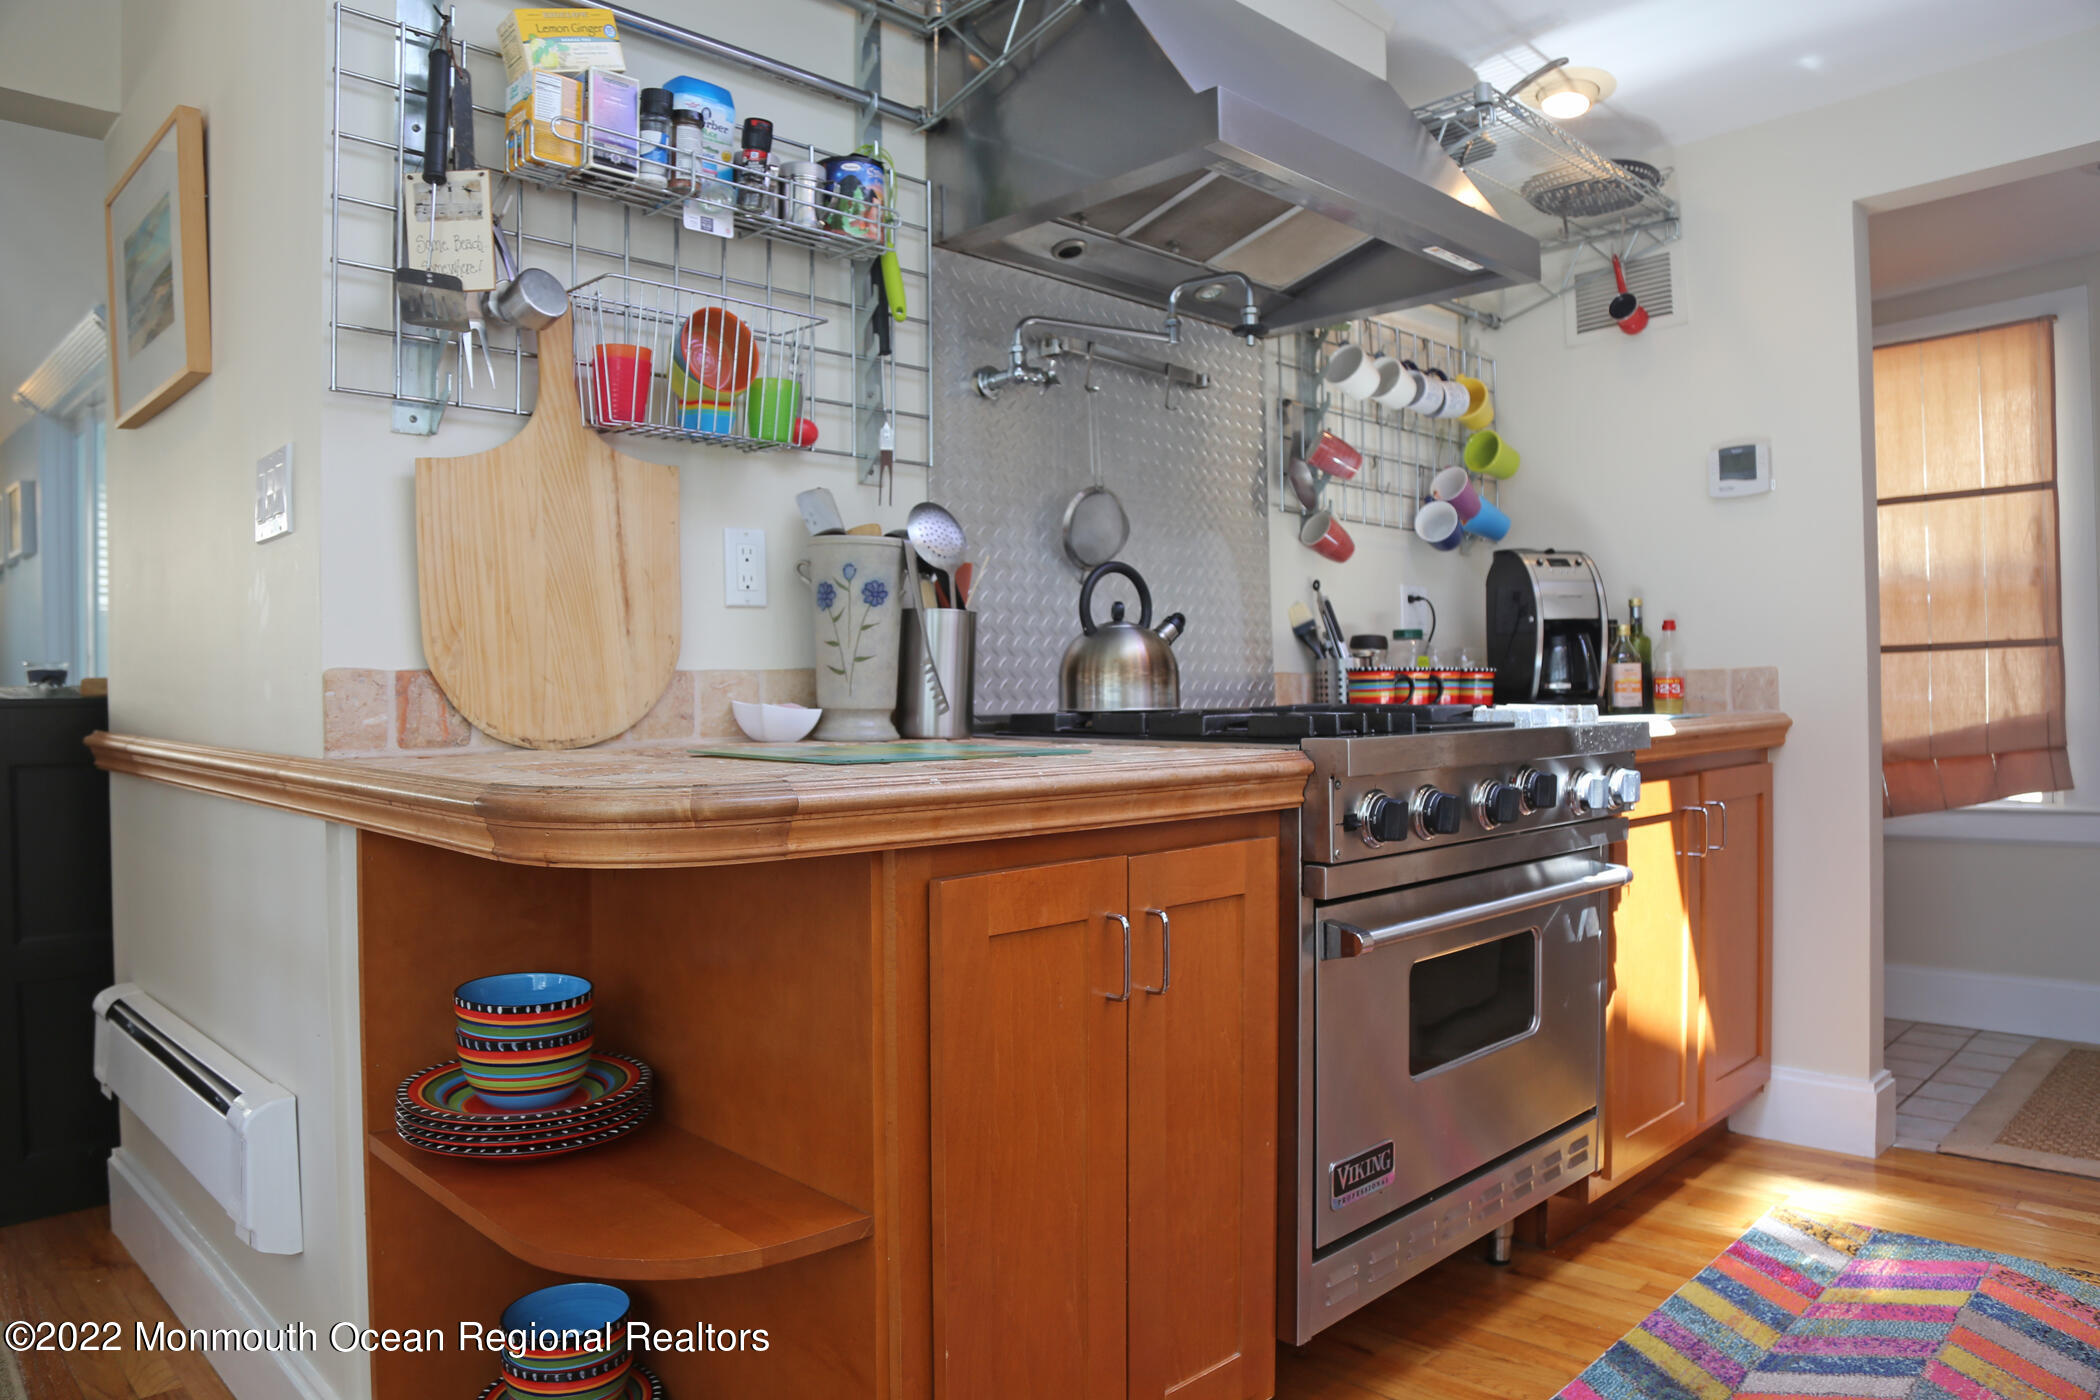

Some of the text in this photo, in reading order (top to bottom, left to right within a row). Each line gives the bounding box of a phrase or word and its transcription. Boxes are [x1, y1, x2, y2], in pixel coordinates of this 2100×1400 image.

[535, 22, 604, 37] Lemon Ginger
[703, 120, 729, 134] rber
[416, 232, 485, 254] Some Beach
[421, 258, 484, 278] mewhere!
[1337, 1149, 1391, 1191] VIKING
[1337, 1176, 1389, 1206] PROFESSIONAL
